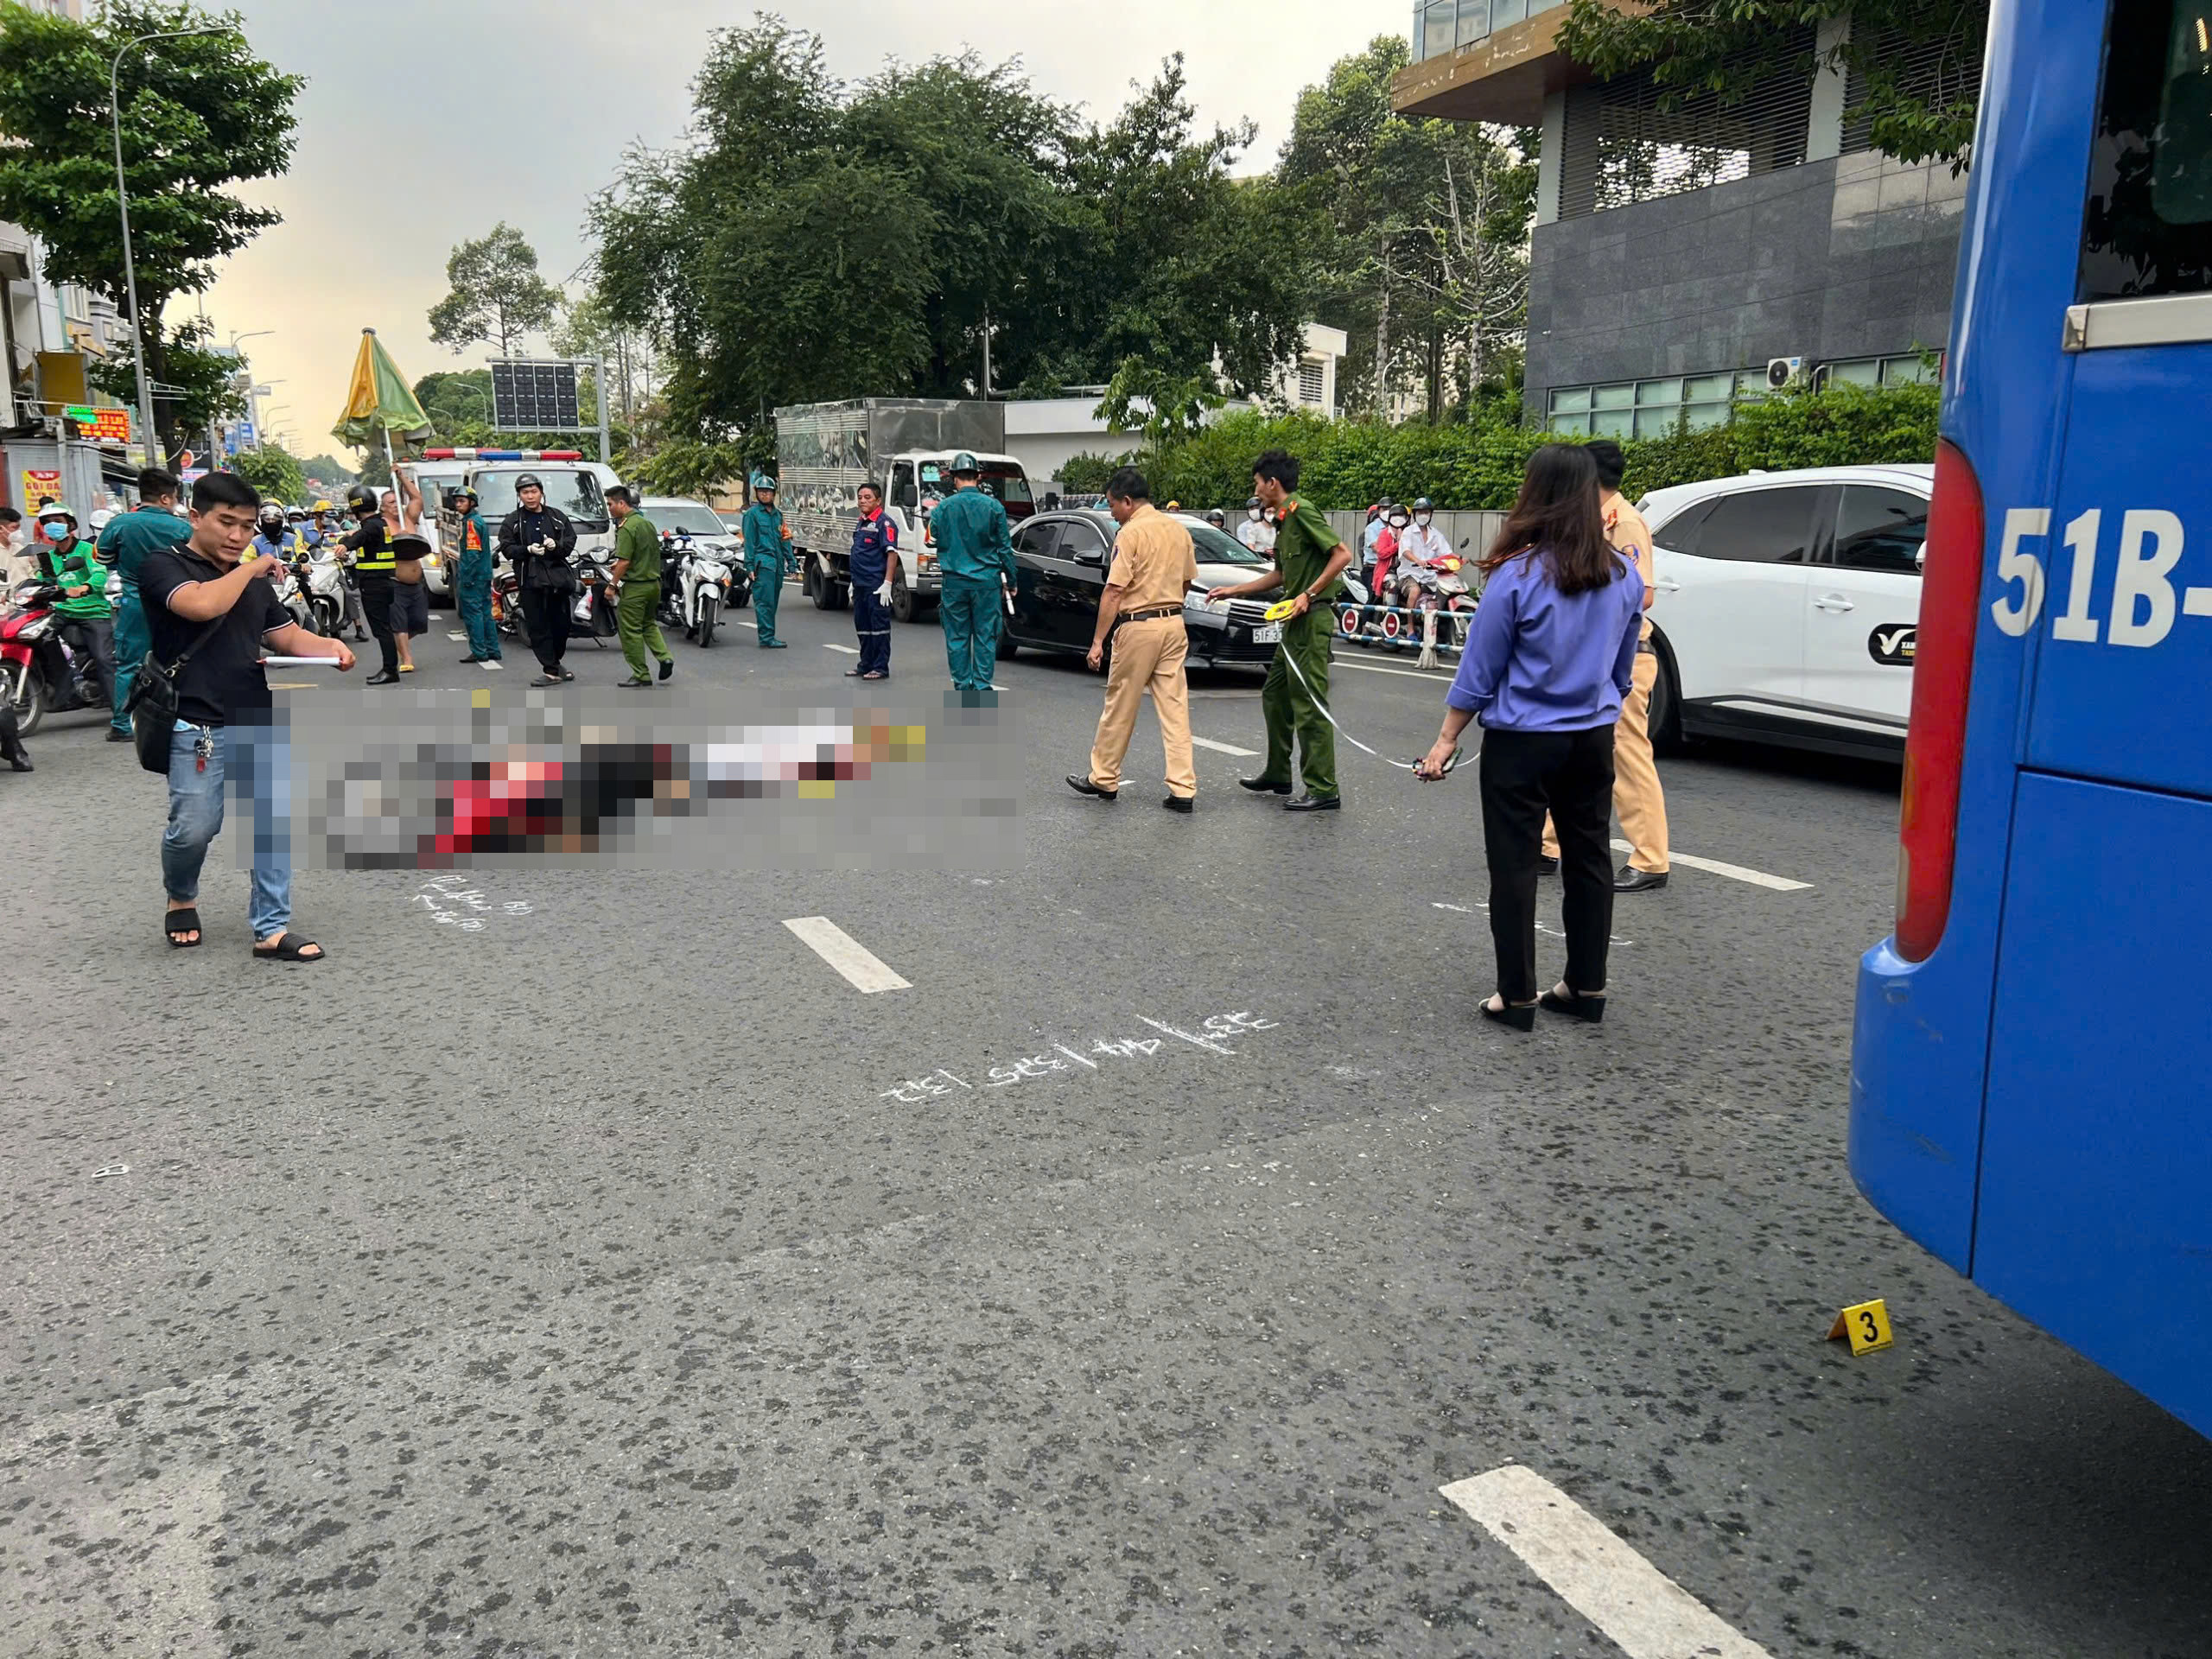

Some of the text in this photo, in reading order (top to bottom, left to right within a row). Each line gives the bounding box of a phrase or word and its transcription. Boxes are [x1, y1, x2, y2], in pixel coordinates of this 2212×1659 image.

[1992, 508, 2212, 647] 51B-
[1255, 630, 1281, 641] 51F-3
[1859, 1311, 1878, 1343] 3
